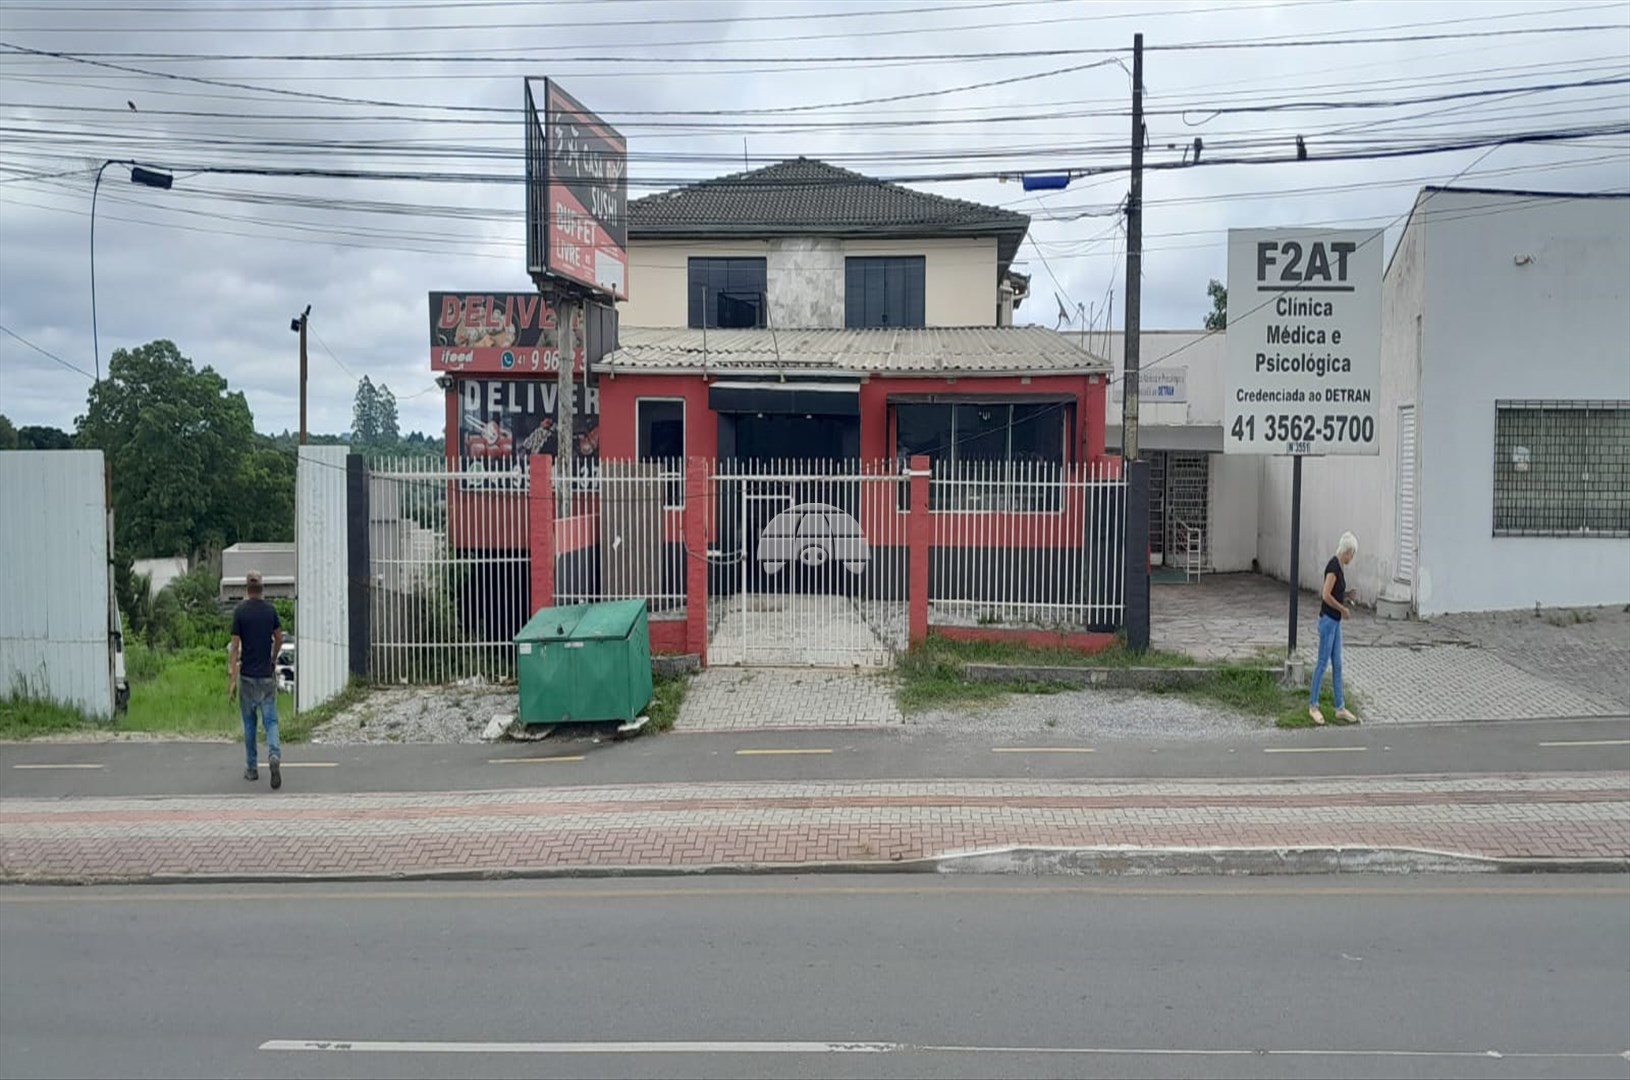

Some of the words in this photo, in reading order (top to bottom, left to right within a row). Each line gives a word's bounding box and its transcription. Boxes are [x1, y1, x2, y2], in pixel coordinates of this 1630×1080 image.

[591, 186, 618, 227] SUSHI
[556, 201, 598, 246] BUFFET
[556, 237, 581, 267] LIVRE
[1256, 241, 1356, 282] F2AT
[1275, 297, 1333, 317] Clínica
[1266, 324, 1326, 345] Médica
[1331, 329, 1342, 345] e
[531, 350, 540, 371] 9
[1255, 352, 1351, 377] Psicológica
[1236, 388, 1306, 403] Credenciada
[1308, 391, 1322, 403] ao
[1325, 388, 1371, 403] DETRAN
[1231, 414, 1256, 441] 41
[1264, 414, 1374, 442] 3562-5700
